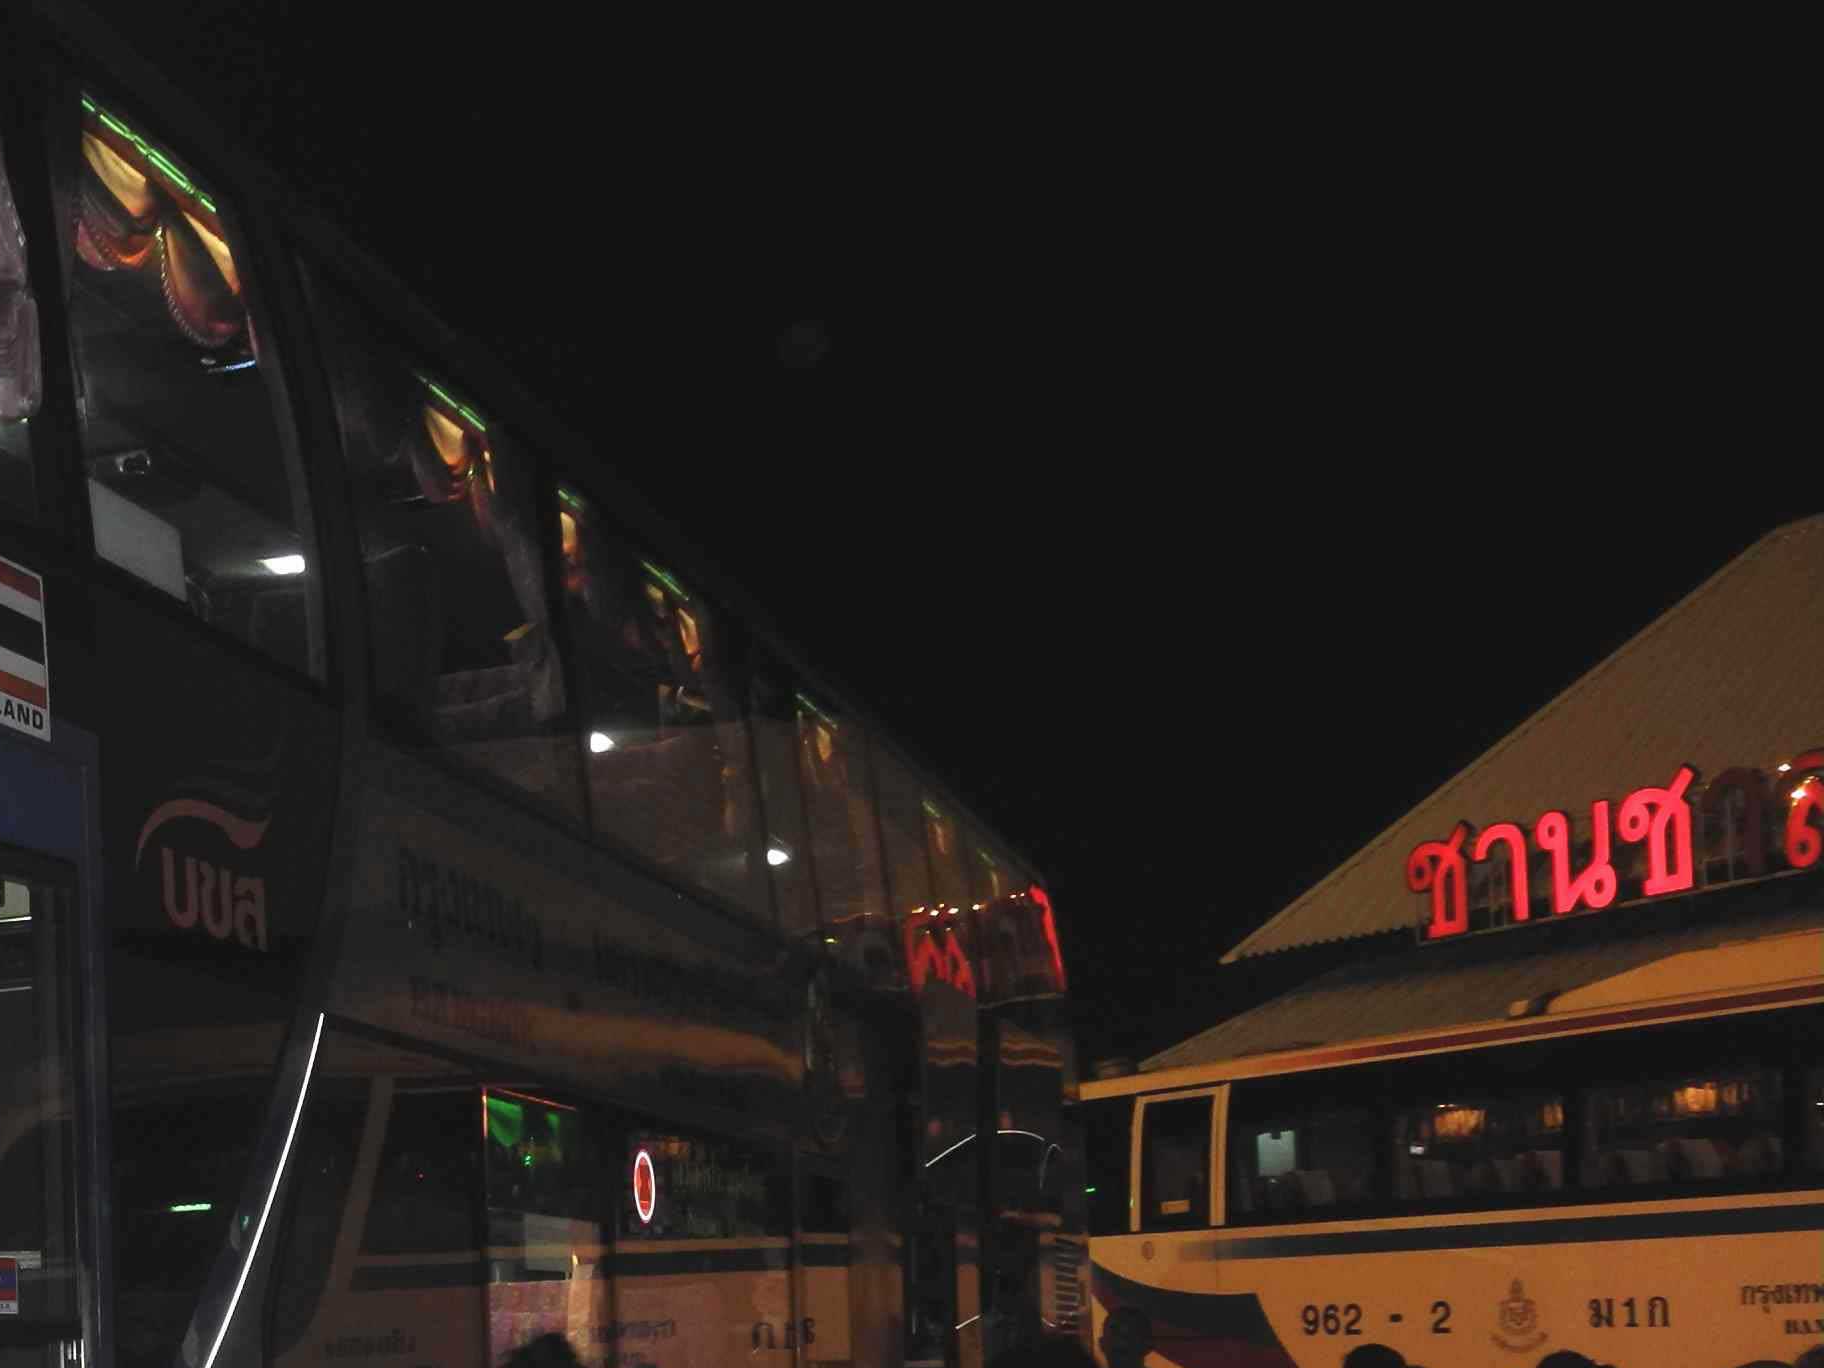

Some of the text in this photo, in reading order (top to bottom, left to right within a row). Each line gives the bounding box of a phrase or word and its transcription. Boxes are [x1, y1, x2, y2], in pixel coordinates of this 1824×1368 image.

[160, 846, 270, 953] บขส
[1301, 1303, 1362, 1335] 962
[1430, 1301, 1453, 1334] 2
